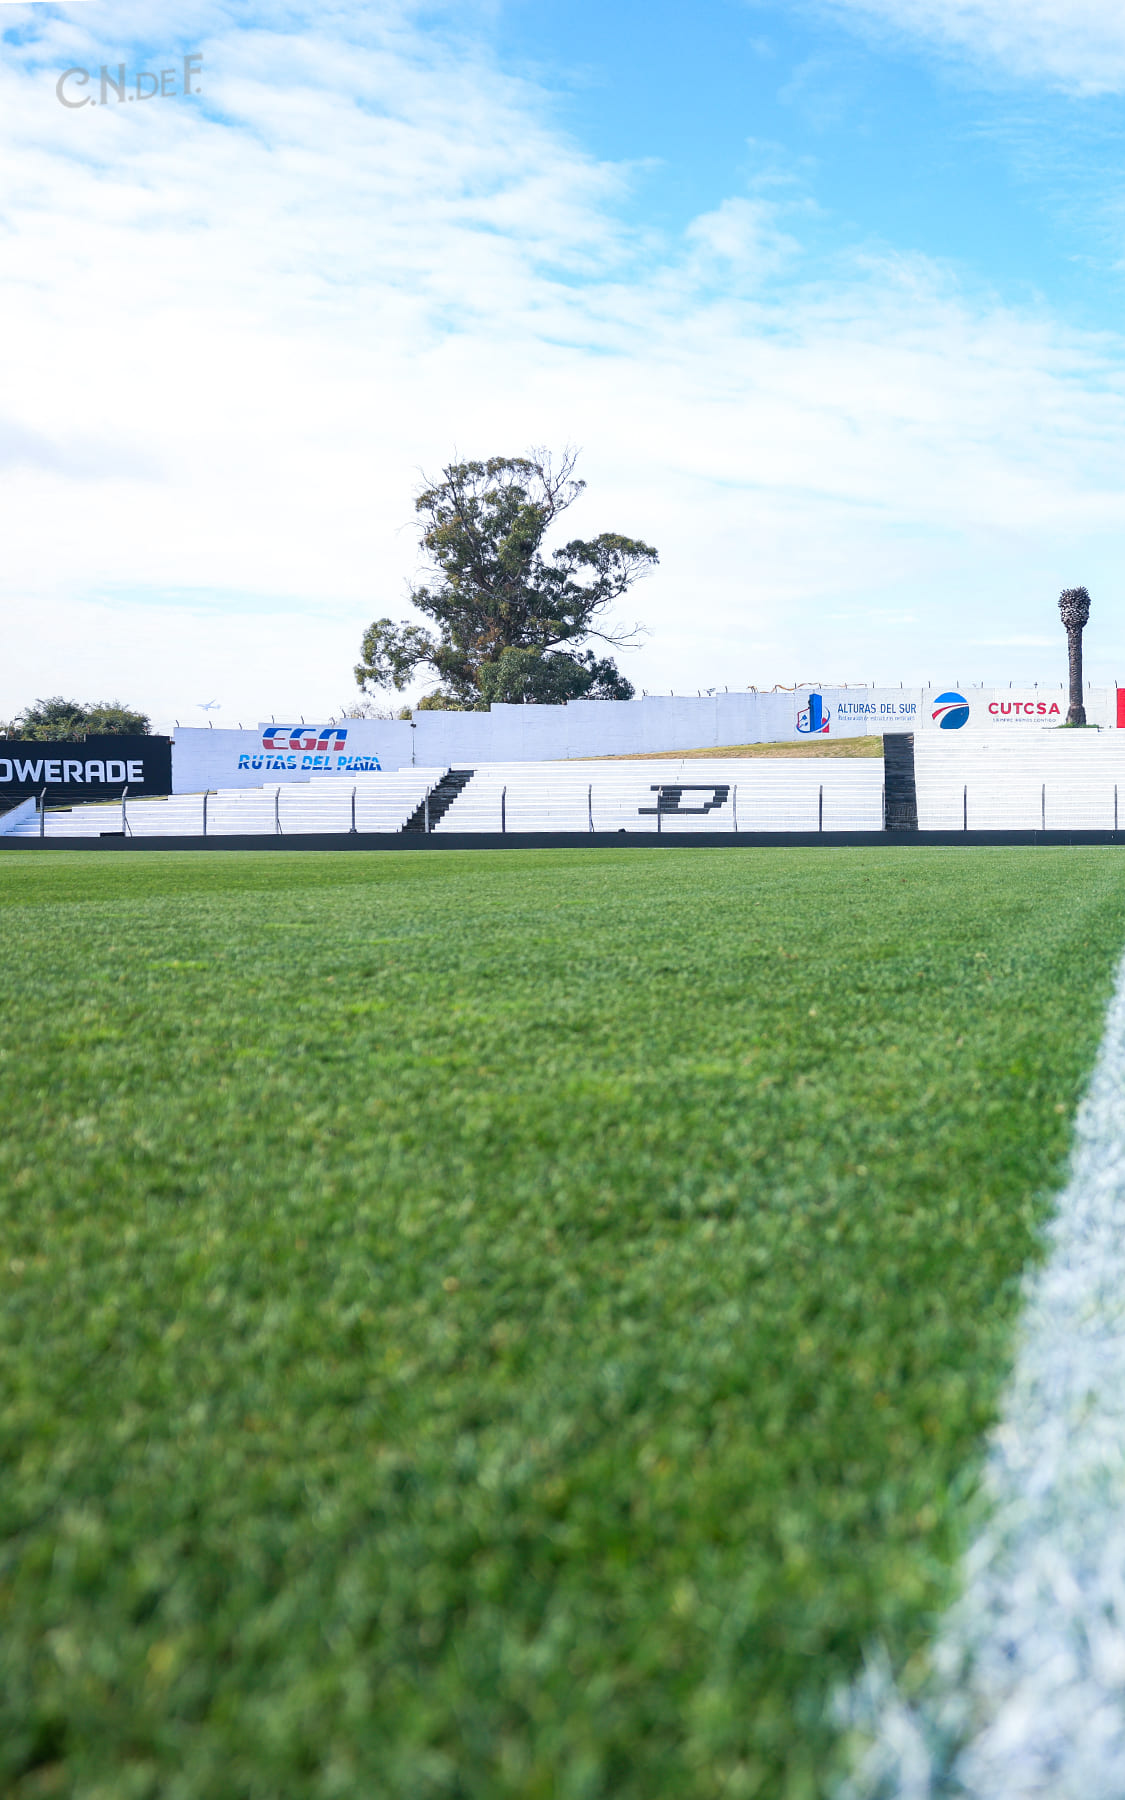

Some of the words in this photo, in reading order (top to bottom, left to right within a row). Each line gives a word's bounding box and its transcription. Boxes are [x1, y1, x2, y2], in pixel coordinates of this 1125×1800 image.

[838, 703, 877, 714] ALTURAS
[880, 703, 897, 714] DEL
[899, 703, 917, 714] SUR
[988, 702, 1061, 715] CUTCSA
[238, 754, 297, 770] RUTAS
[301, 755, 332, 770] DEL
[337, 756, 382, 771] PLATA
[638, 785, 730, 815] D
